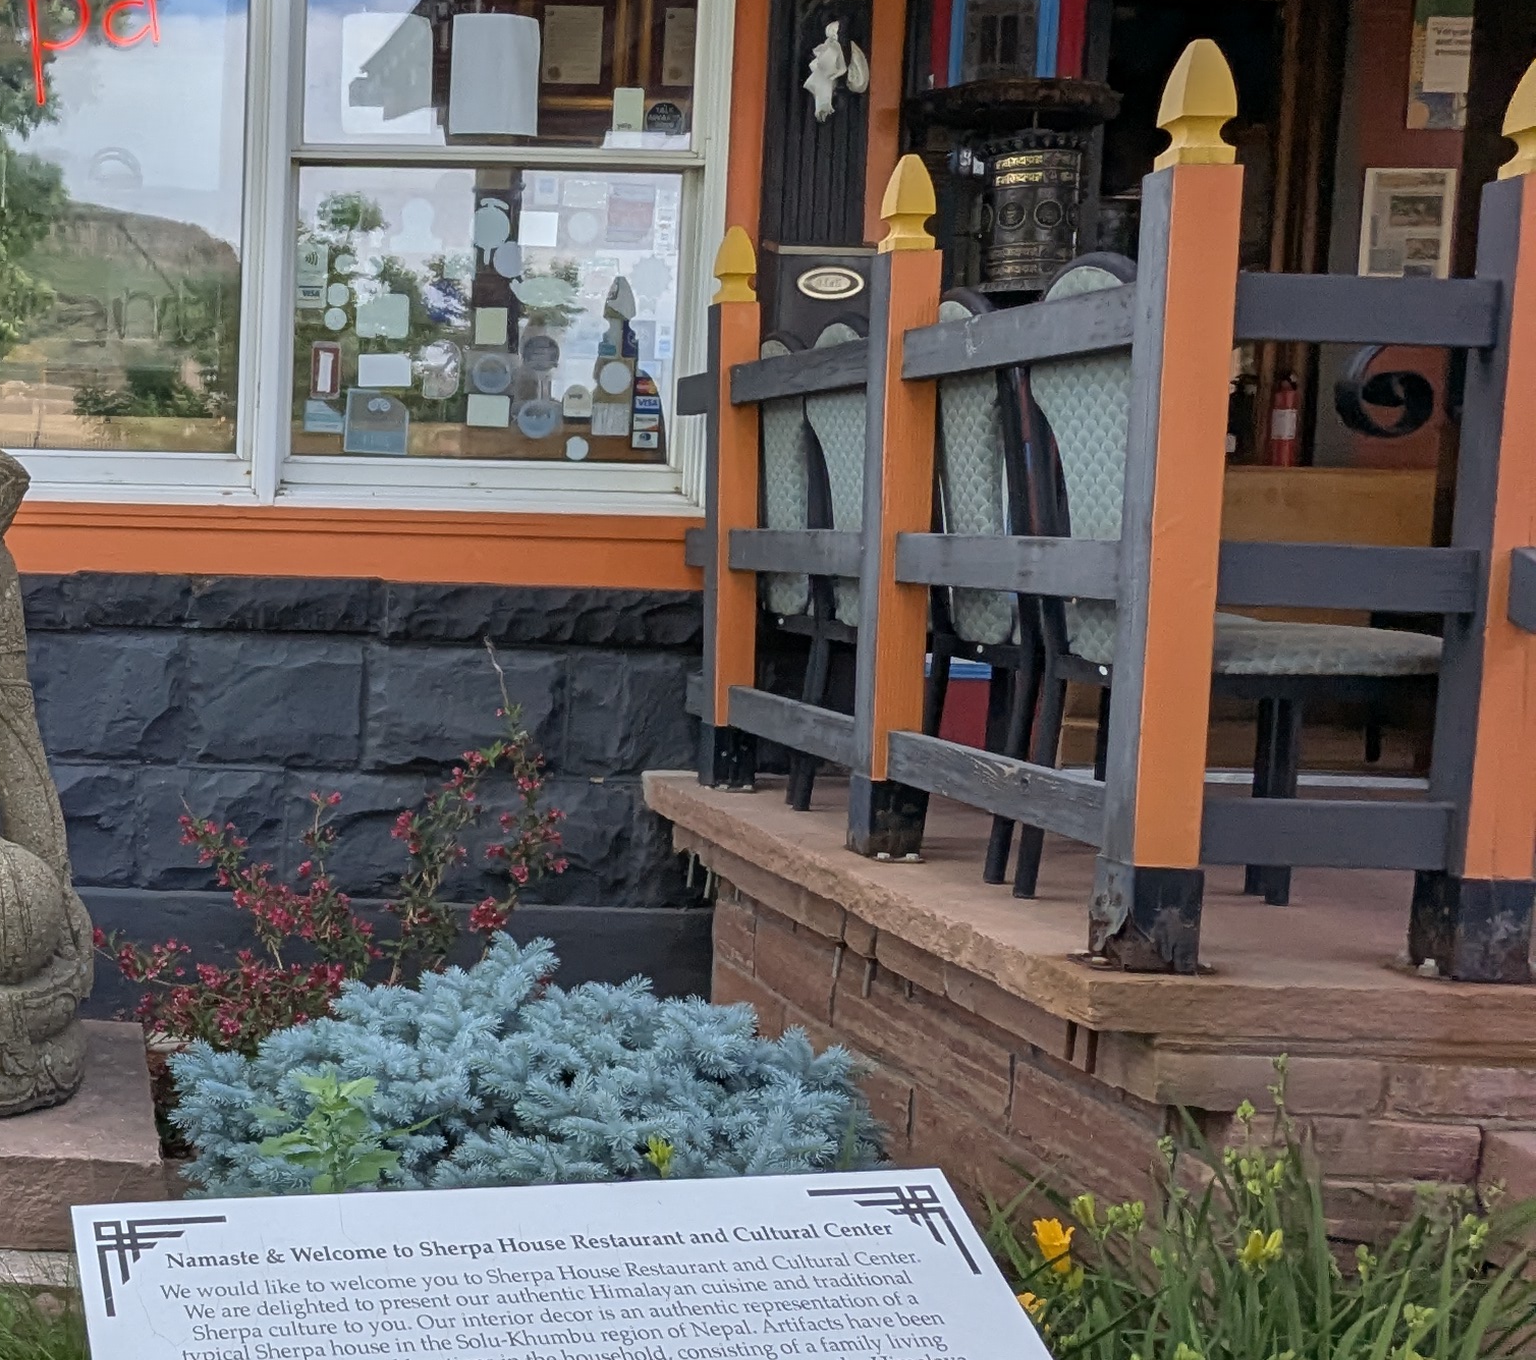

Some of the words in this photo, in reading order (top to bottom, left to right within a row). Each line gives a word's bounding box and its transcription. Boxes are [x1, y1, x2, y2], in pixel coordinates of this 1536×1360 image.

[638, 398, 658, 407] VISA
[164, 1251, 260, 1269] Namaste
[265, 1248, 286, 1265] &
[289, 1245, 388, 1263] Welcome
[392, 1243, 414, 1258] to
[418, 1240, 495, 1258] Sherpa
[496, 1237, 567, 1253] House
[569, 1231, 686, 1250] Restaurant
[689, 1227, 730, 1245] and
[732, 1223, 821, 1243] Cultural
[823, 1222, 893, 1238] Center
[159, 1283, 192, 1300] We
[195, 1279, 261, 1298] would
[264, 1278, 301, 1295] like
[305, 1279, 326, 1293] to
[329, 1275, 418, 1291] welcome
[420, 1275, 460, 1293] you
[463, 1272, 483, 1285] to
[485, 1267, 556, 1288] Sherpa
[555, 1264, 622, 1281] House
[624, 1259, 729, 1278] Restaurant
[732, 1255, 770, 1272] and
[771, 1251, 852, 1270] Cultural
[853, 1251, 921, 1267] Center.
[183, 1303, 216, 1321] We
[221, 1305, 251, 1318] are
[256, 1296, 351, 1320] delighted
[354, 1297, 375, 1312] to
[378, 1293, 452, 1316] present
[455, 1294, 490, 1307] our
[495, 1285, 587, 1305] authentic
[587, 1281, 698, 1300] Himalayan
[700, 1277, 769, 1295] cuisine
[772, 1274, 811, 1291] and
[812, 1269, 914, 1289] traditional
[192, 1324, 264, 1345] Sherpa
[268, 1320, 338, 1338] culture
[343, 1319, 364, 1334] to
[367, 1320, 413, 1338] you.
[416, 1313, 457, 1330] Our
[461, 1310, 535, 1328] interior
[539, 1307, 594, 1324] decor
[597, 1305, 616, 1321] is
[620, 1307, 646, 1320] an
[648, 1299, 740, 1319] authentic
[741, 1293, 881, 1318] representation
[882, 1290, 904, 1307] of
[906, 1294, 920, 1306] a
[328, 1339, 391, 1357] house
[394, 1337, 417, 1353] in
[420, 1334, 453, 1352] the
[455, 1327, 597, 1350] Solu-Khumbu
[600, 1325, 664, 1347] region
[667, 1321, 689, 1339] of
[688, 1318, 758, 1342] Nepal.
[763, 1315, 845, 1334] Artifacts
[843, 1313, 896, 1330] have
[893, 1311, 945, 1327] been
[677, 1341, 779, 1360] consisting
[779, 1337, 802, 1355] of
[804, 1342, 819, 1354] a
[819, 1334, 881, 1356] family
[884, 1332, 949, 1353] living
